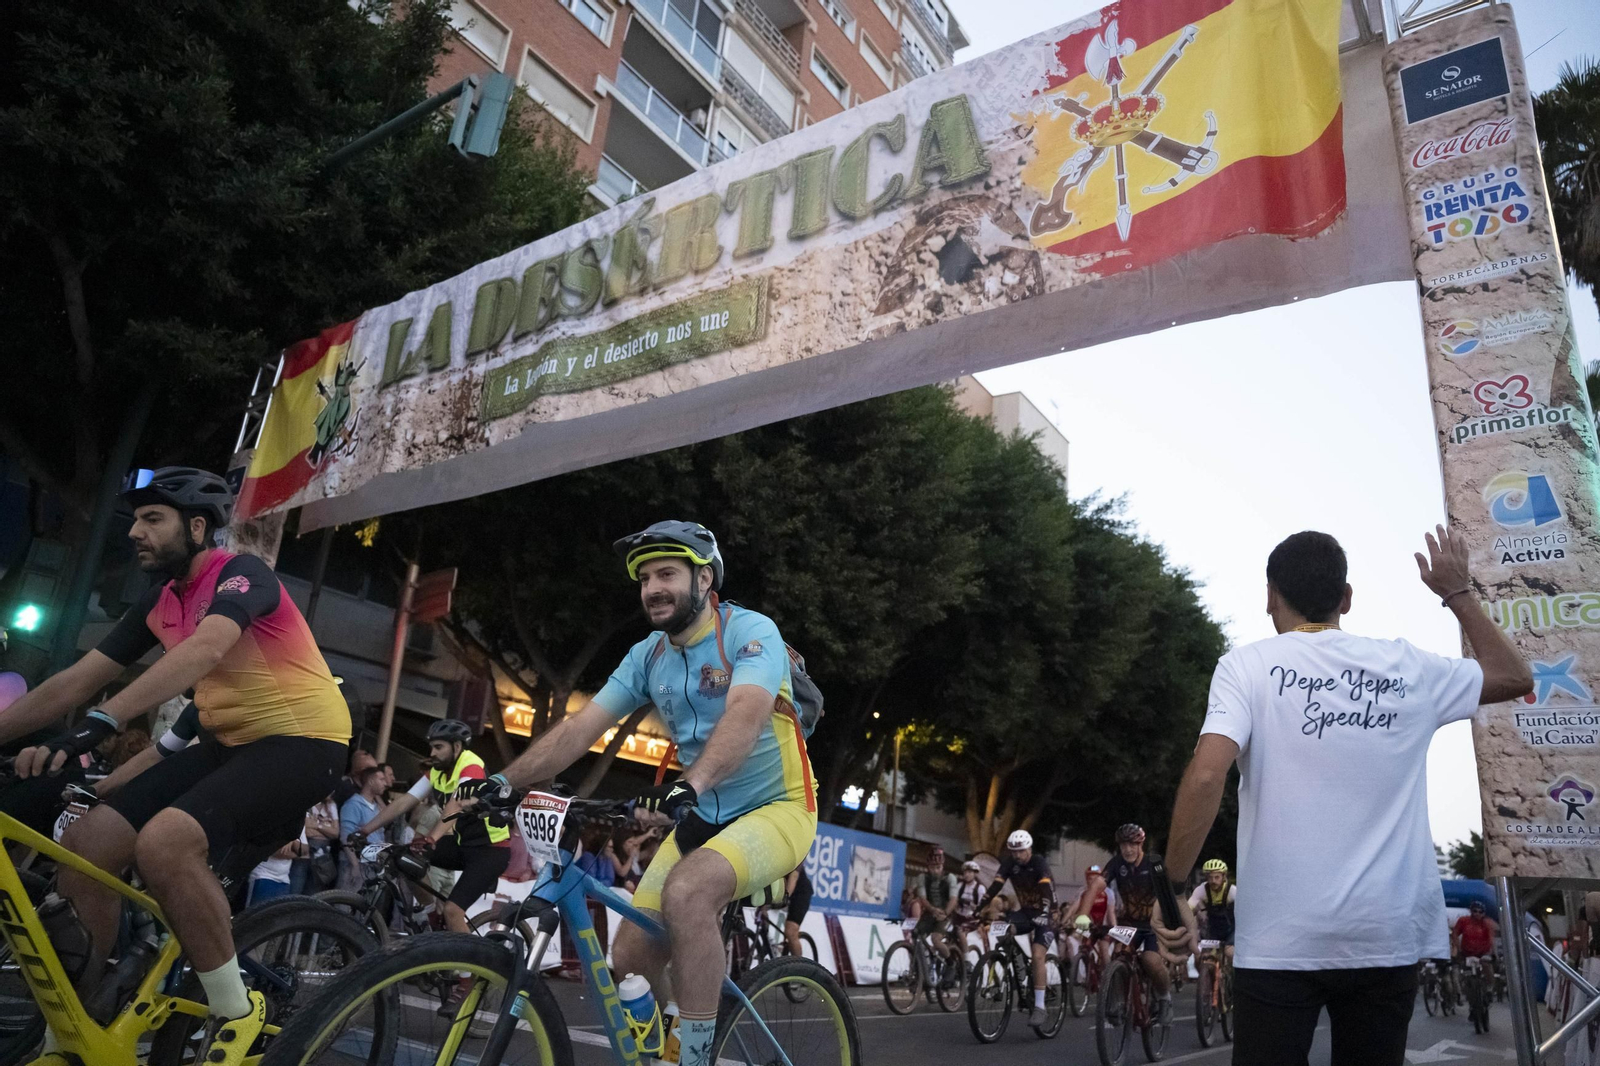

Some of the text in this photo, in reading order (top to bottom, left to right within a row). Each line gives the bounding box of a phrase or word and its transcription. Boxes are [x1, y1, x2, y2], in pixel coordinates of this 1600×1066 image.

[1425, 75, 1482, 99] SENATOR
[1412, 117, 1516, 168] Coca-Cola
[1423, 167, 1518, 200] GRUPO
[1424, 181, 1526, 222] RENTA
[1427, 203, 1530, 244] TODO
[379, 92, 993, 394] LA DESÉRTICA
[1484, 309, 1551, 330] Andalucía
[1485, 332, 1507, 341] Región
[1508, 326, 1536, 336] Europeo
[503, 375, 519, 396] La
[565, 356, 578, 377] y
[583, 353, 599, 370] el
[603, 331, 660, 364] desierto
[665, 321, 692, 344] nos
[699, 310, 730, 334] une
[1454, 407, 1572, 445] primaflor
[1493, 531, 1568, 550] Almería
[1501, 548, 1566, 565] Activa
[659, 684, 673, 695] Bar
[714, 674, 729, 683] Bar
[1270, 665, 1408, 705] Pepe Yepes
[1301, 700, 1399, 740] Speaker
[523, 811, 559, 844] 5998
[1506, 824, 1600, 834] COSTADEAL
